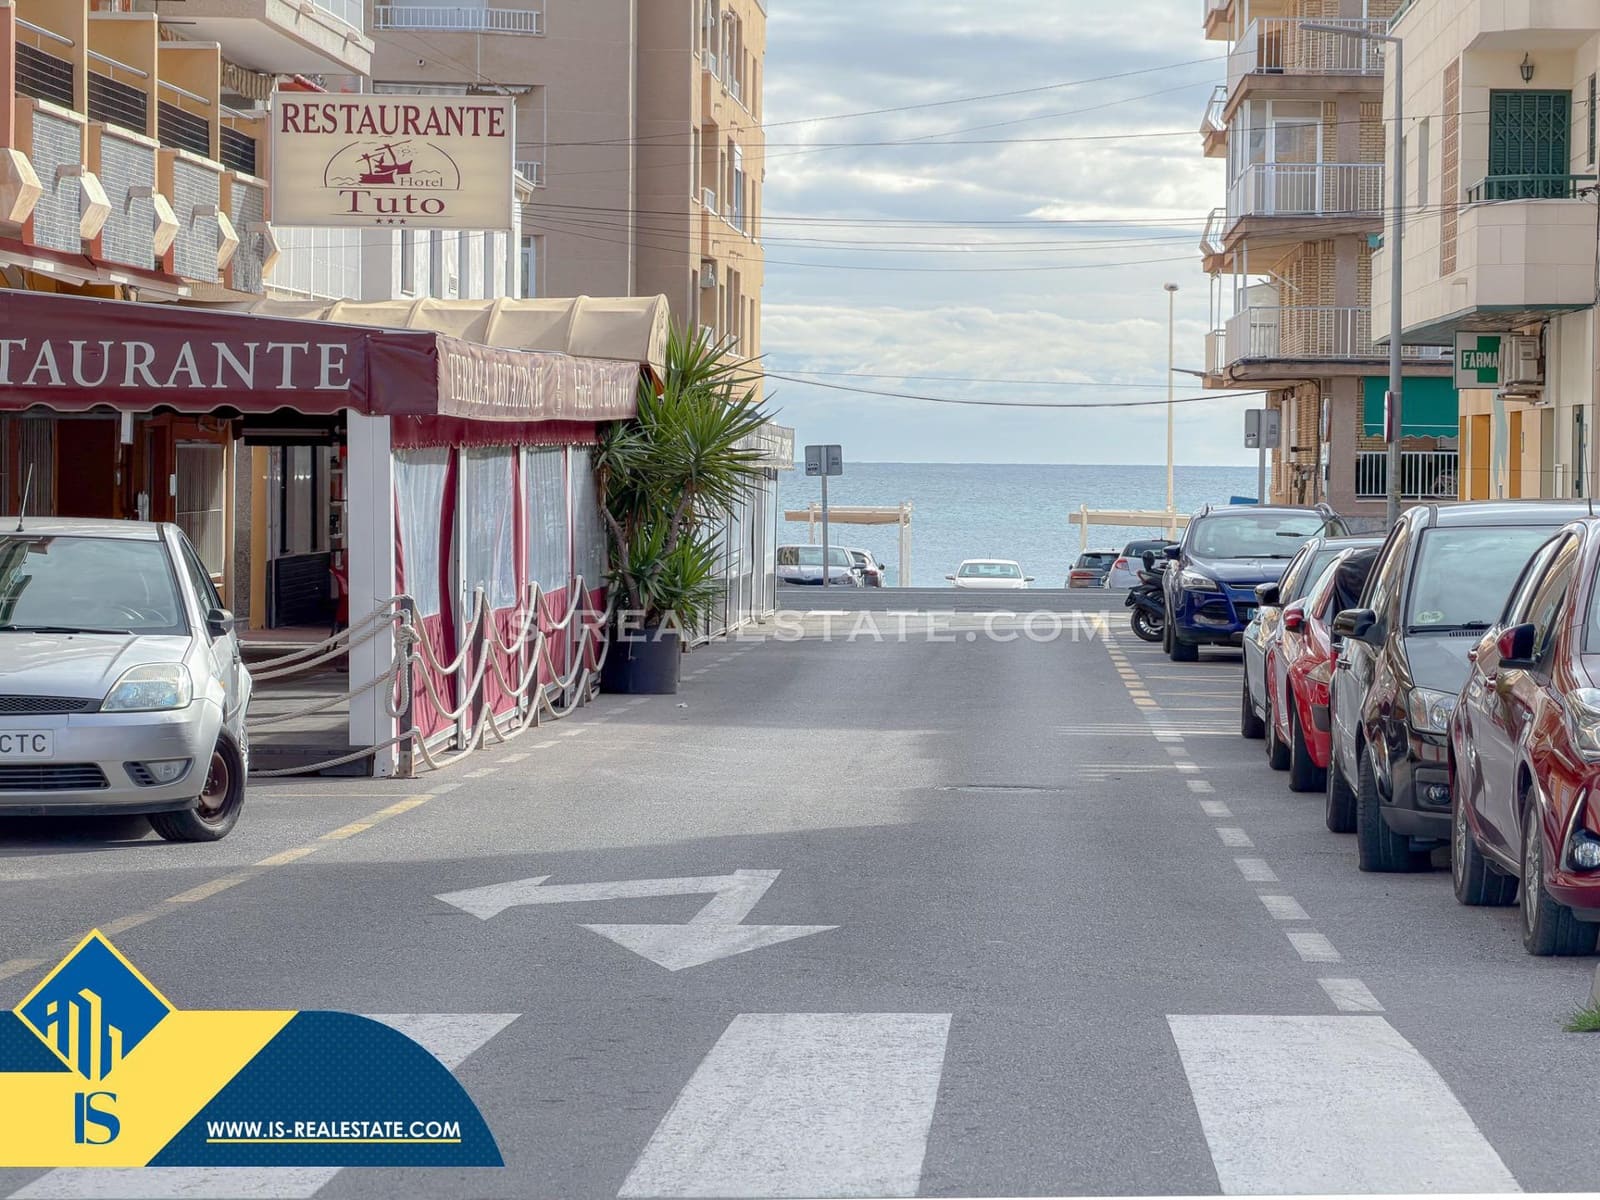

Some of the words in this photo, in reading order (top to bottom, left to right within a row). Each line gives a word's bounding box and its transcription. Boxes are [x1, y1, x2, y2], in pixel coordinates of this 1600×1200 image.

[281, 103, 505, 137] RESTAURANTE
[400, 176, 443, 188] Hotel
[339, 190, 445, 214] Tuto
[0, 338, 350, 390] TAURANTE
[1462, 351, 1499, 369] FARMA
[448, 353, 489, 405] TERRAZA
[0, 734, 46, 753] CTC
